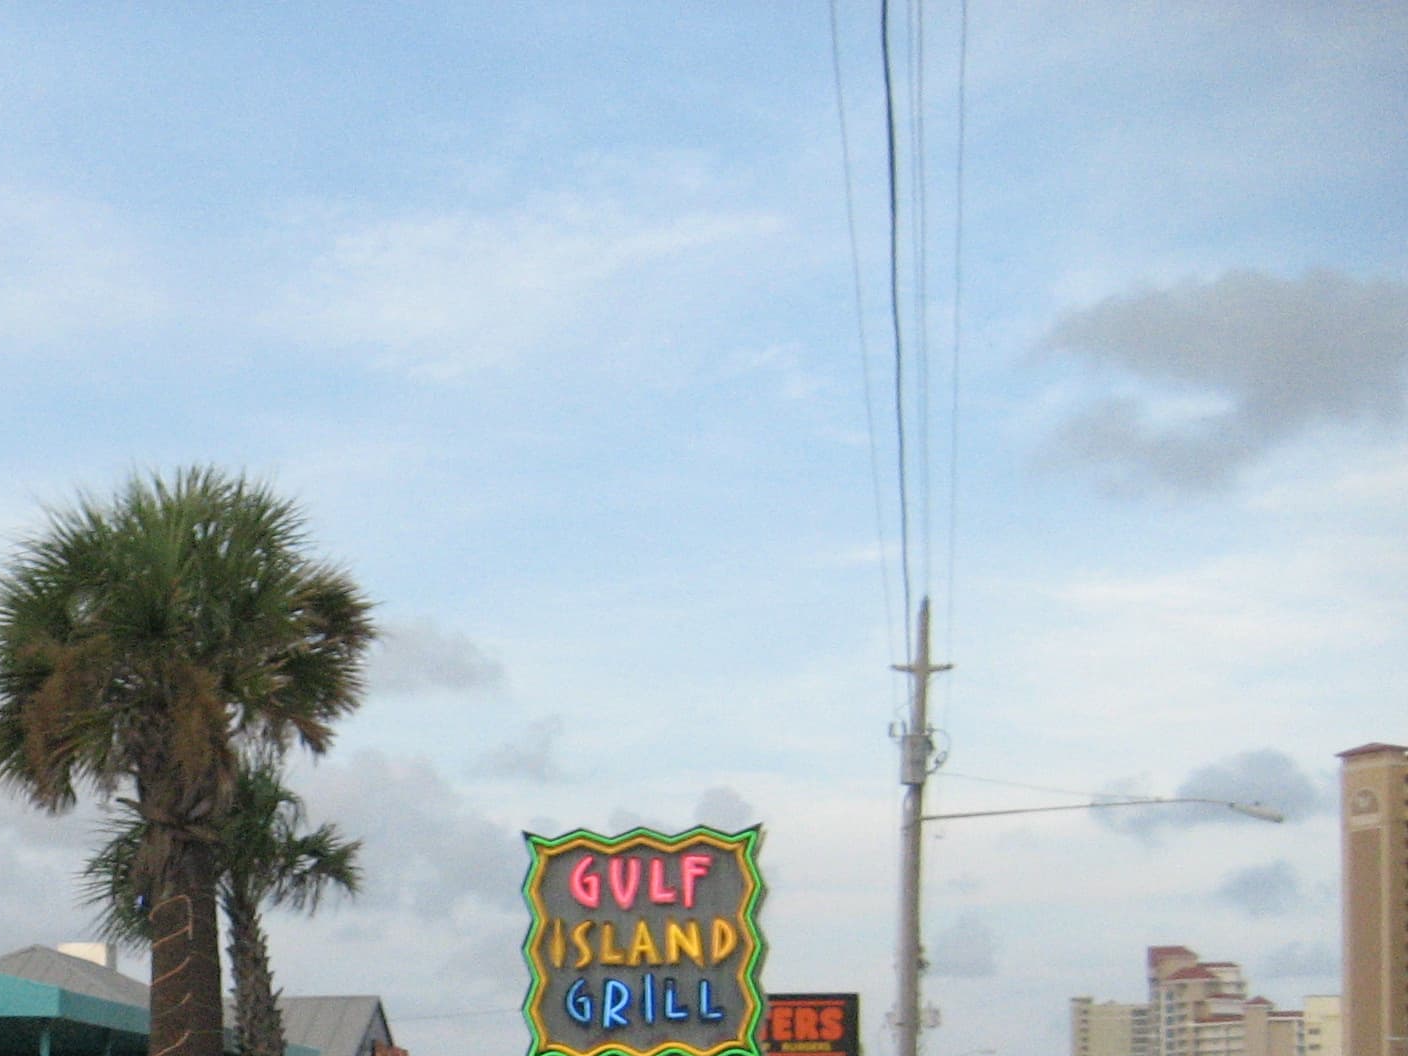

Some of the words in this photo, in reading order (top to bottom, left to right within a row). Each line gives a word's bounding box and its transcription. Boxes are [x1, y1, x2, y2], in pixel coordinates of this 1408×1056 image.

[568, 854, 713, 911] GULF
[549, 916, 739, 968] ISLAND
[565, 973, 725, 1030] GRILL
